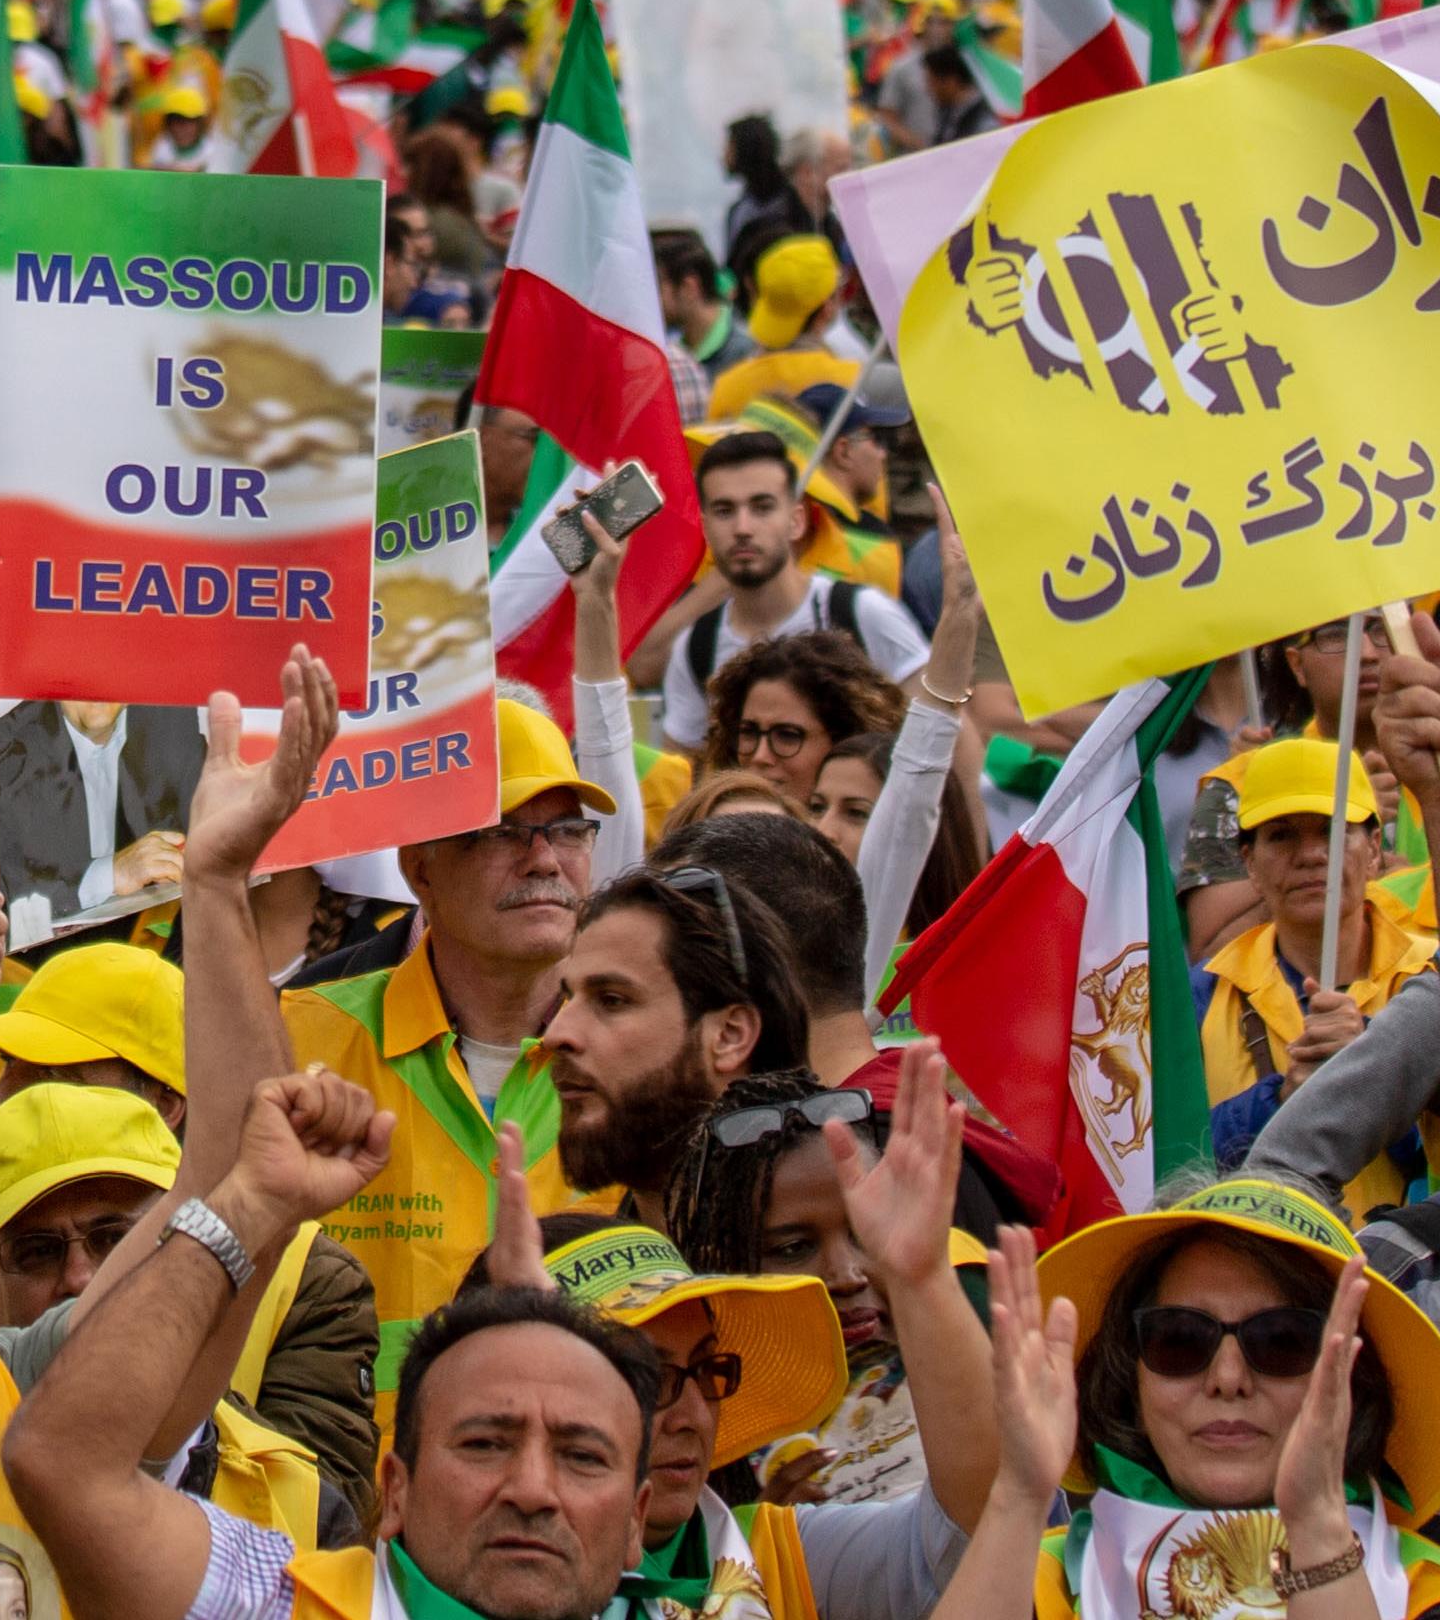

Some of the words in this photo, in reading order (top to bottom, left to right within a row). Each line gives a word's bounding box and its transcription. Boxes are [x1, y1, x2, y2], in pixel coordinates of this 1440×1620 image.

[15, 251, 372, 315] MASSOUD
[154, 356, 226, 410] IS
[104, 462, 269, 520] OUR
[1239, 435, 1437, 548] بزرگ
[1040, 480, 1224, 625] زنان
[32, 560, 335, 621] LEADER
[320, 1222, 381, 1243] aryam
[384, 1219, 443, 1243] Rajavi
[348, 1193, 395, 1213] IRAN
[399, 1191, 443, 1213] with
